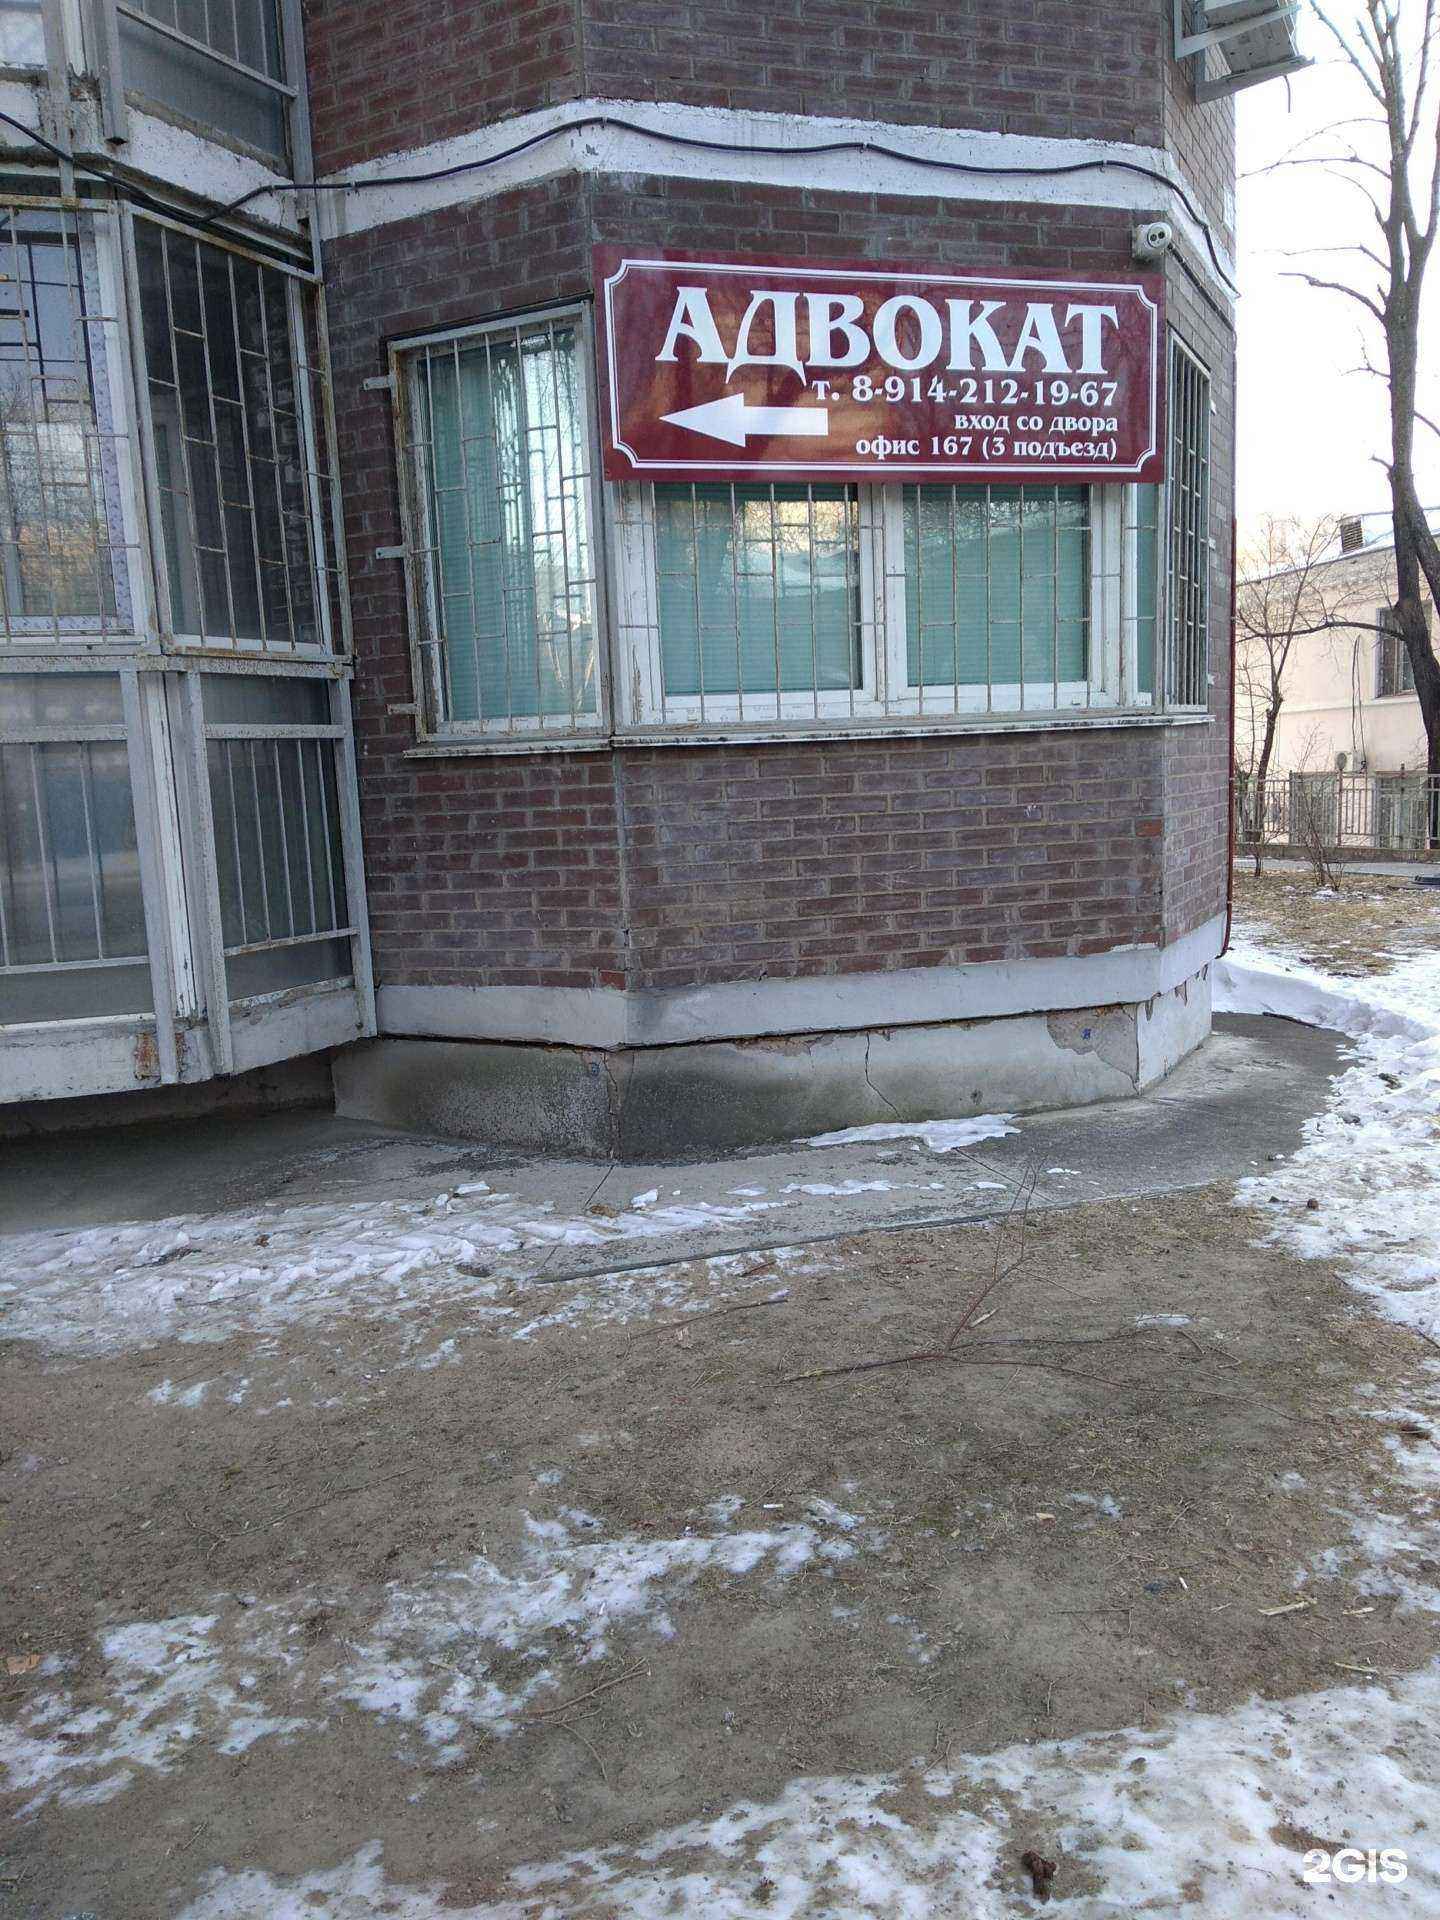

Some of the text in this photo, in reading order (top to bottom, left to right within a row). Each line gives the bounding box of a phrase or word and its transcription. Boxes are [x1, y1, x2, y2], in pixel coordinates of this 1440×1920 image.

[655, 286, 1118, 386] АДВОКАТ
[812, 375, 1118, 407] т. 8-914-212-19-67
[954, 413, 1118, 437] вход со двора
[855, 436, 1118, 461] офис 167 (3 подъезд)
